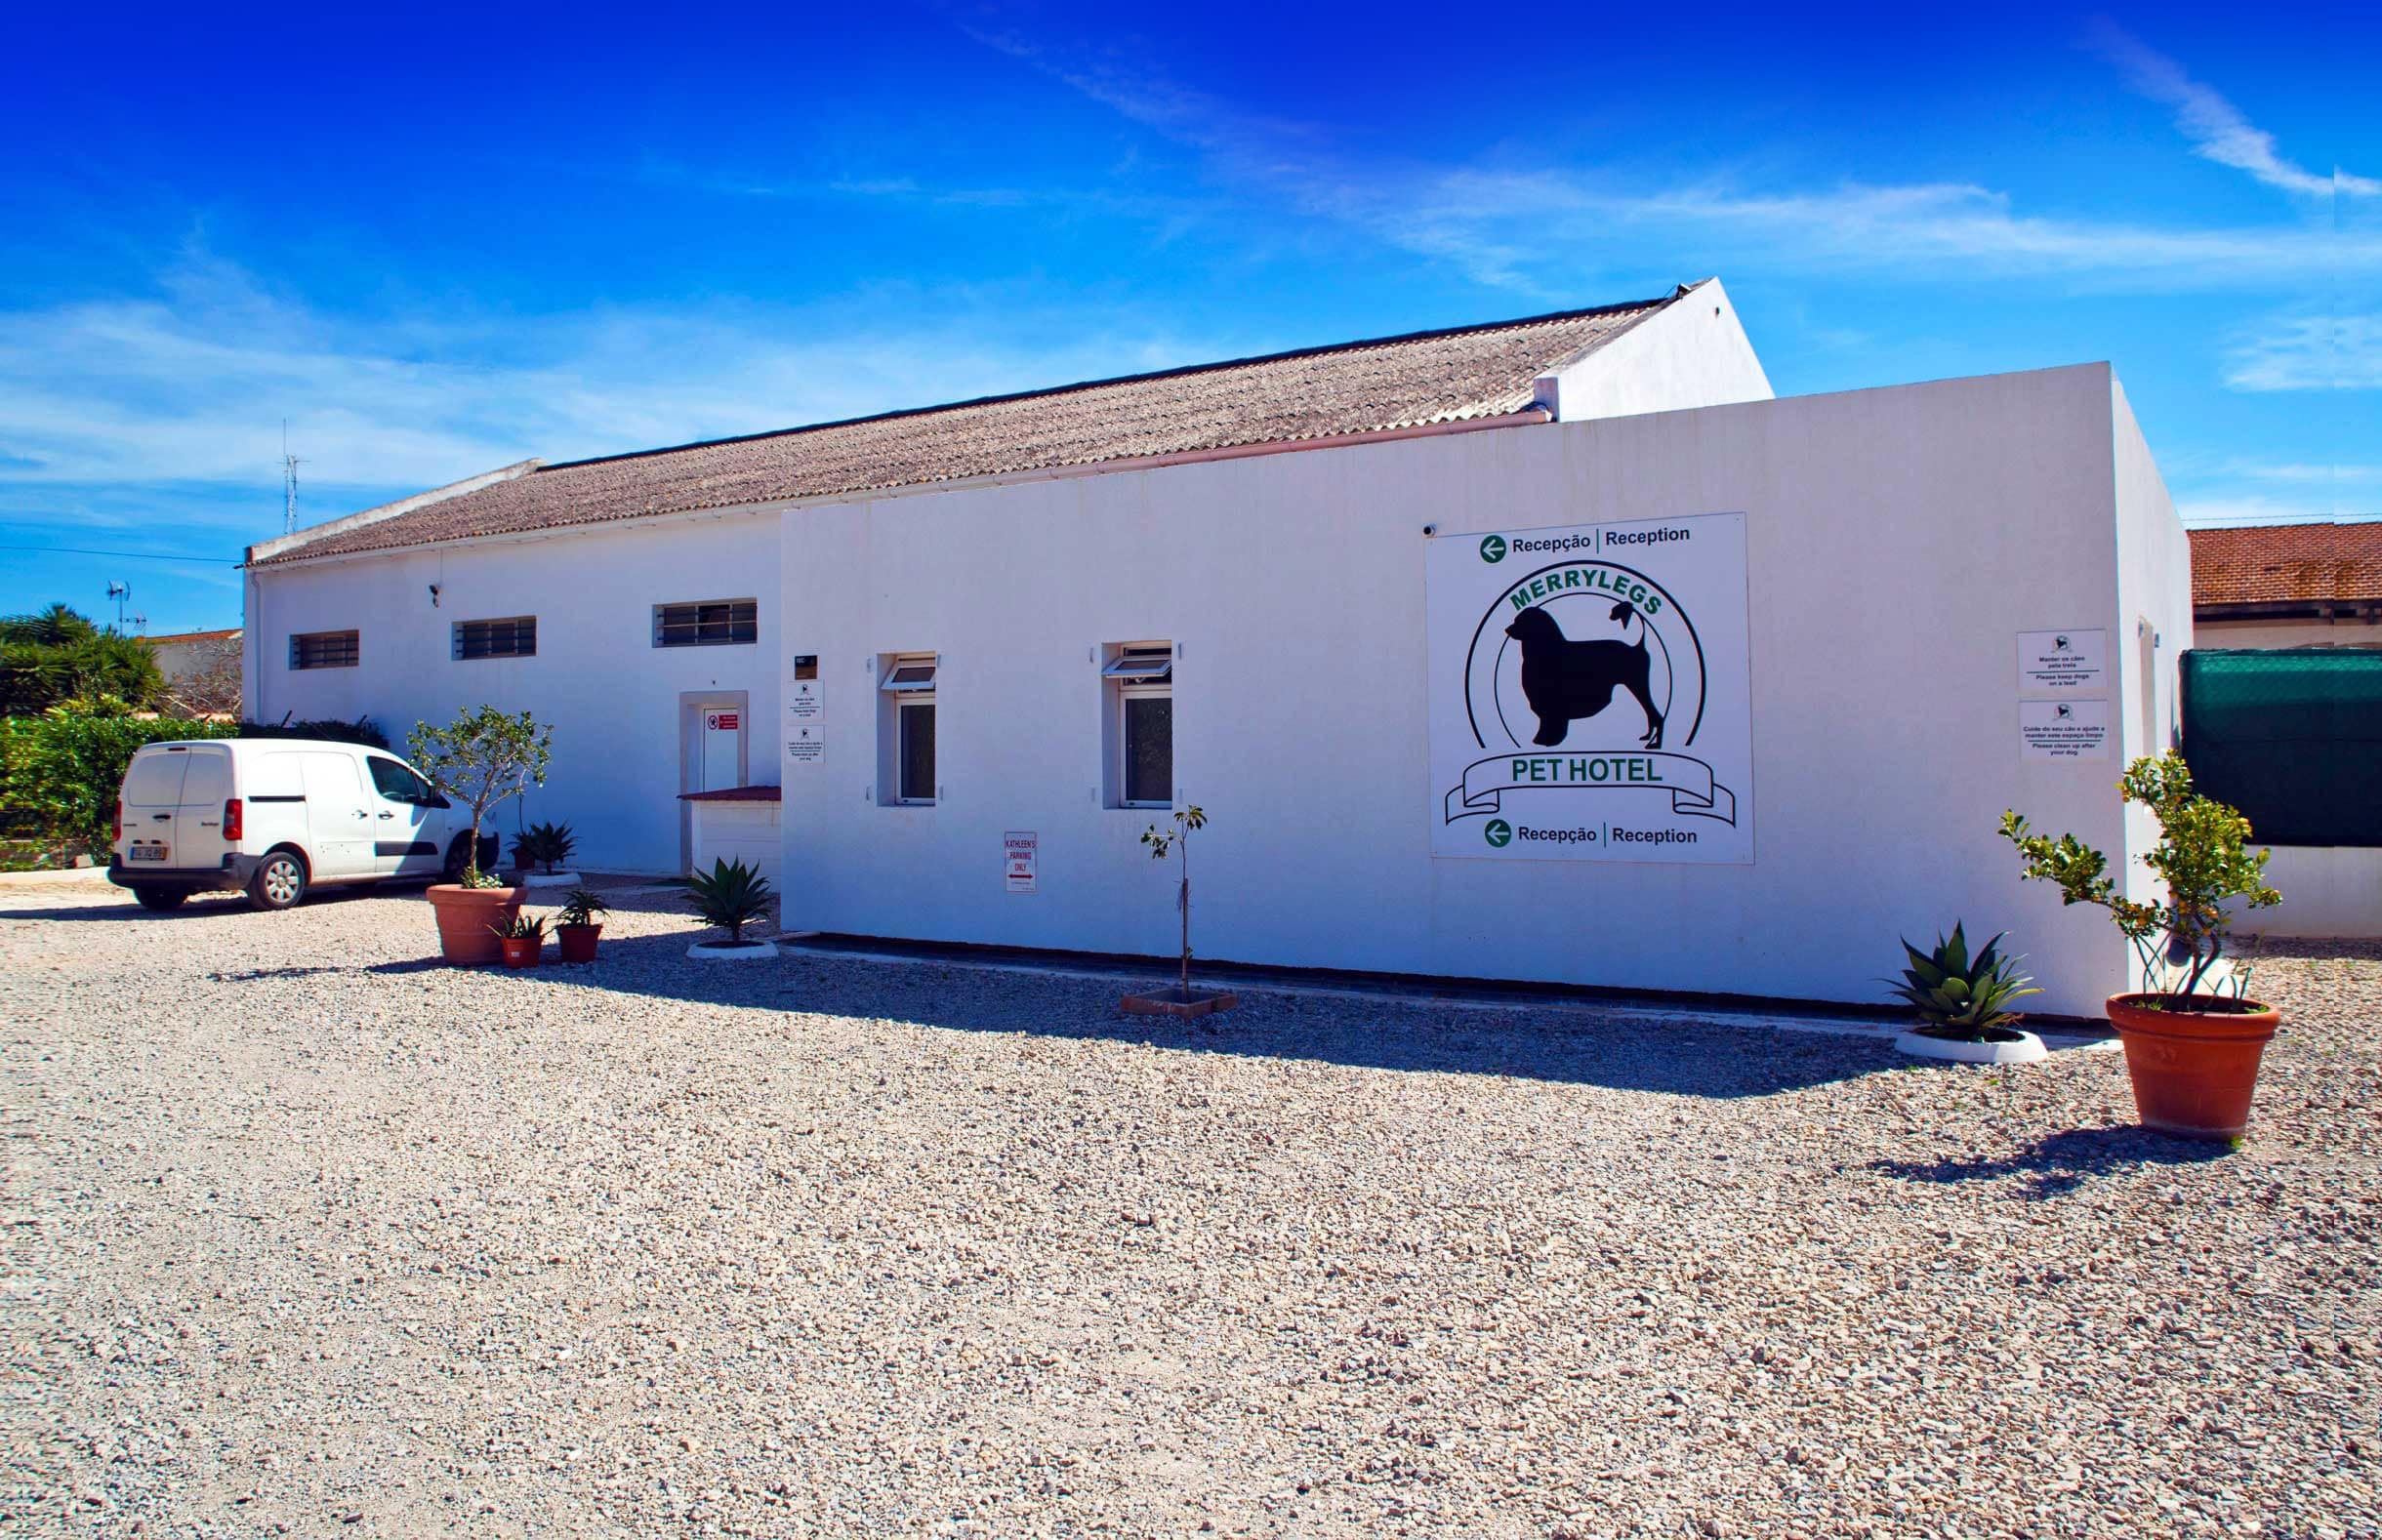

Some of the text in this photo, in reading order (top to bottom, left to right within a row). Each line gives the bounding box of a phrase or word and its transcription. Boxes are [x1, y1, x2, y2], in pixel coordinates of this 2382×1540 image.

[1512, 527, 1691, 553] Recepção Reception
[1509, 569, 1663, 615] MERRYLEGS
[1512, 758, 1663, 782] PET HOTEL
[1518, 826, 1698, 845] Recepção Reception
